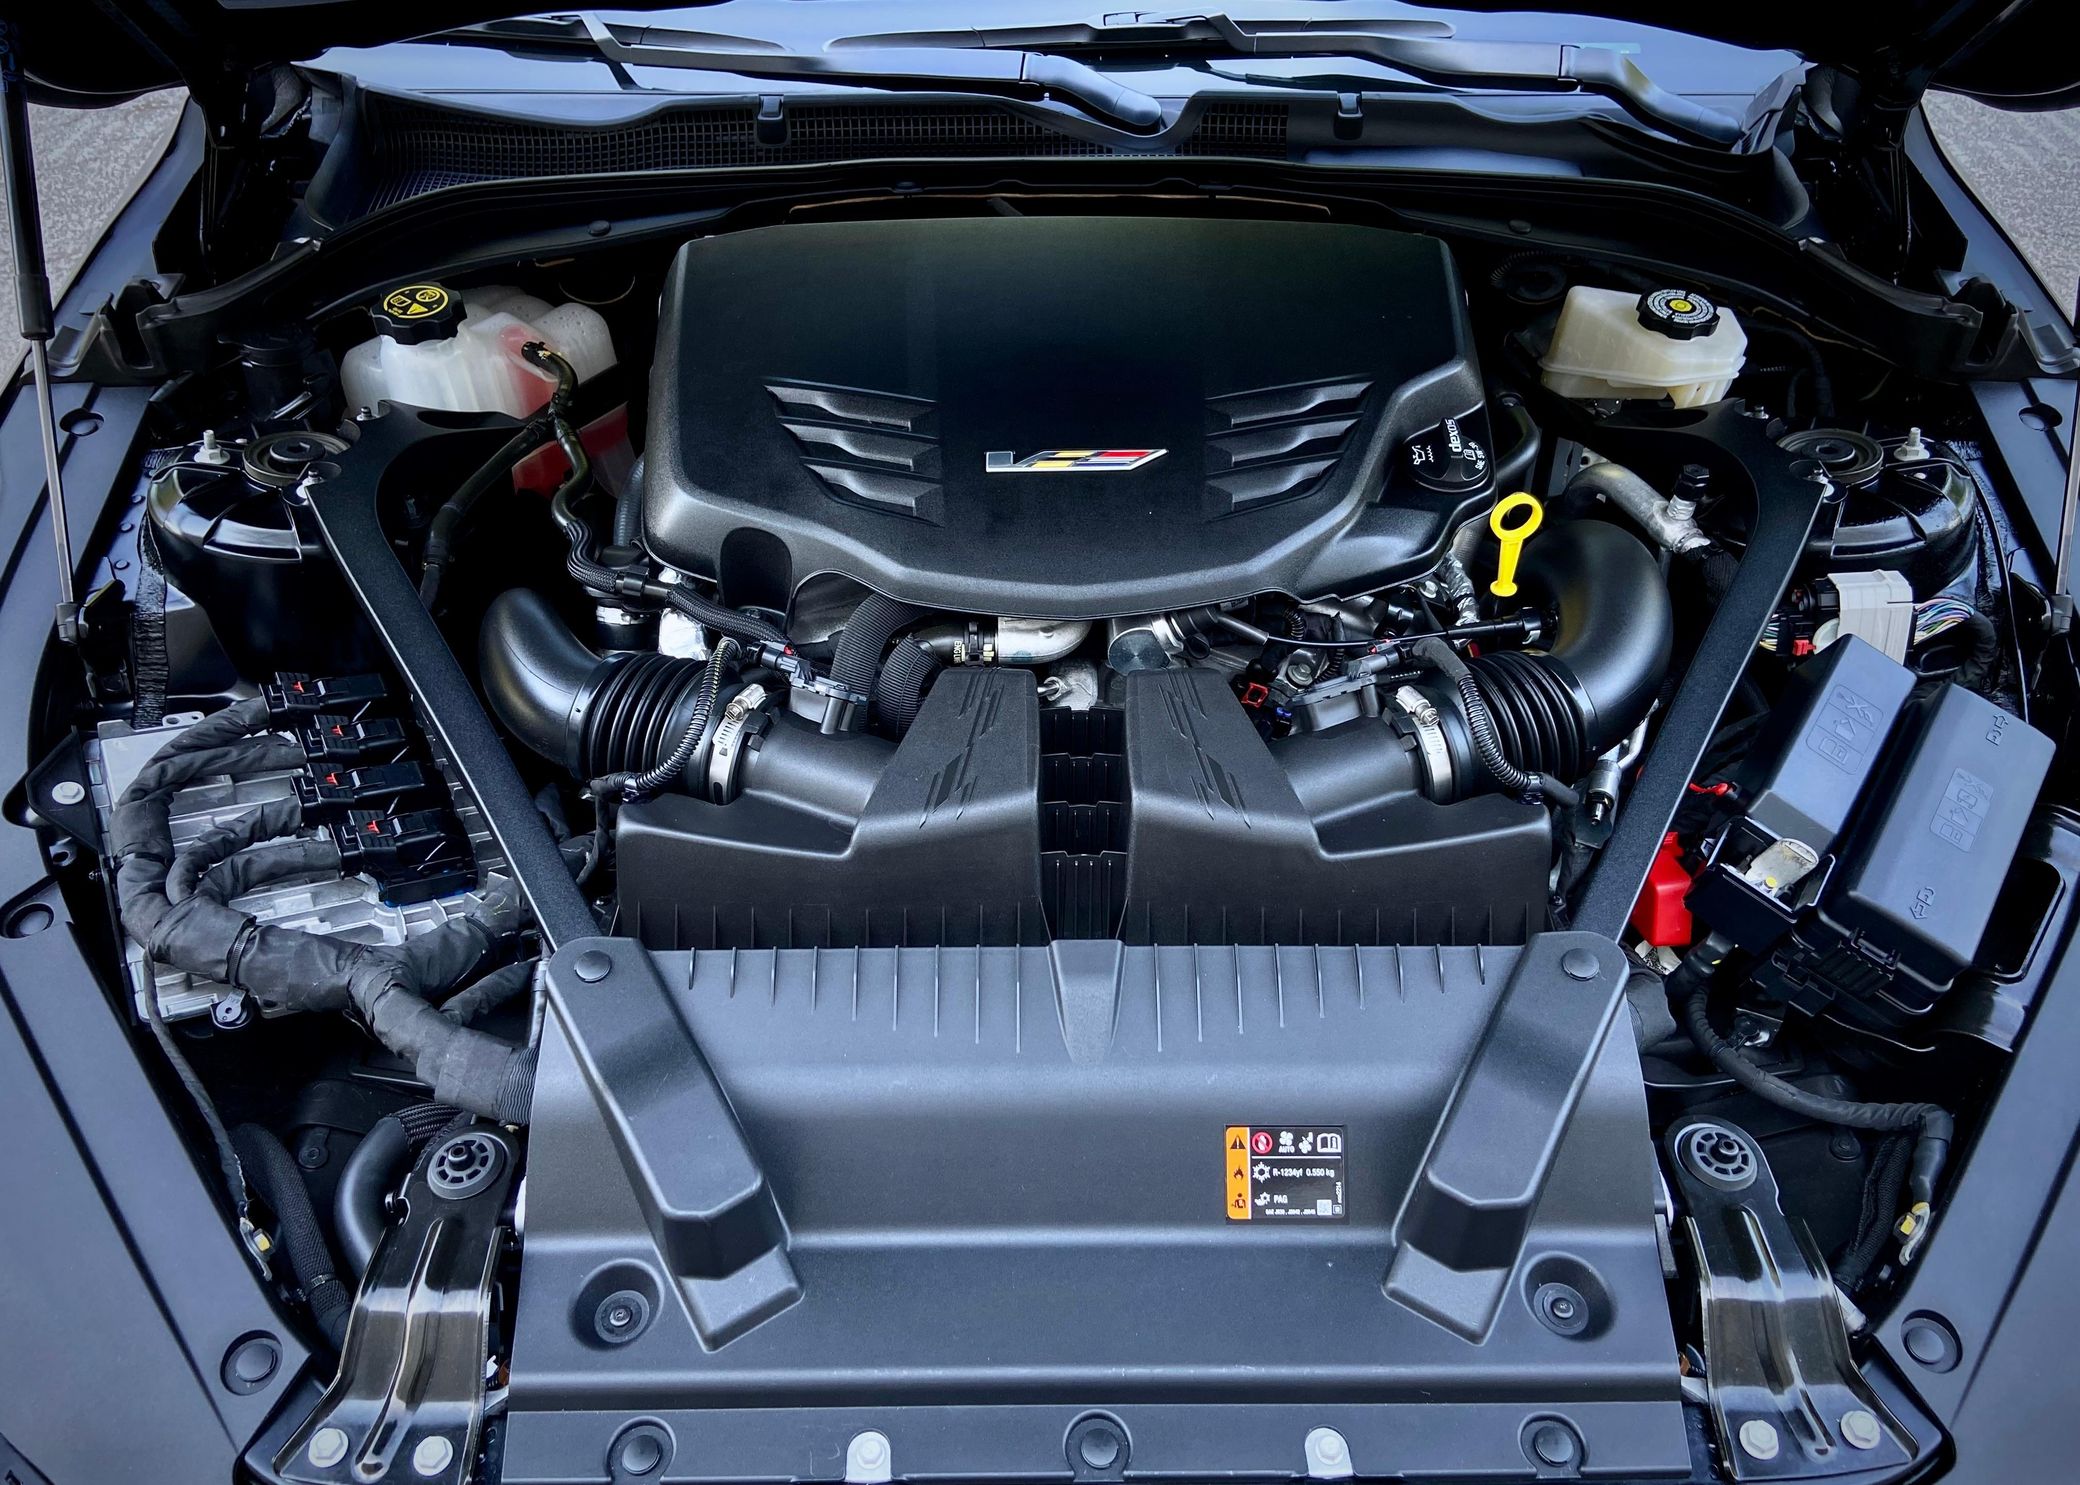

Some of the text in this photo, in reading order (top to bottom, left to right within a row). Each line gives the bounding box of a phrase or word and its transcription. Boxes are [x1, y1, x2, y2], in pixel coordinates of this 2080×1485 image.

[1445, 418, 1462, 452] dexos
[954, 640, 962, 654] ENG
[1272, 1168, 1335, 1178] R-1234yf 0.550 kg
[1274, 1195, 1288, 1204] PAG
